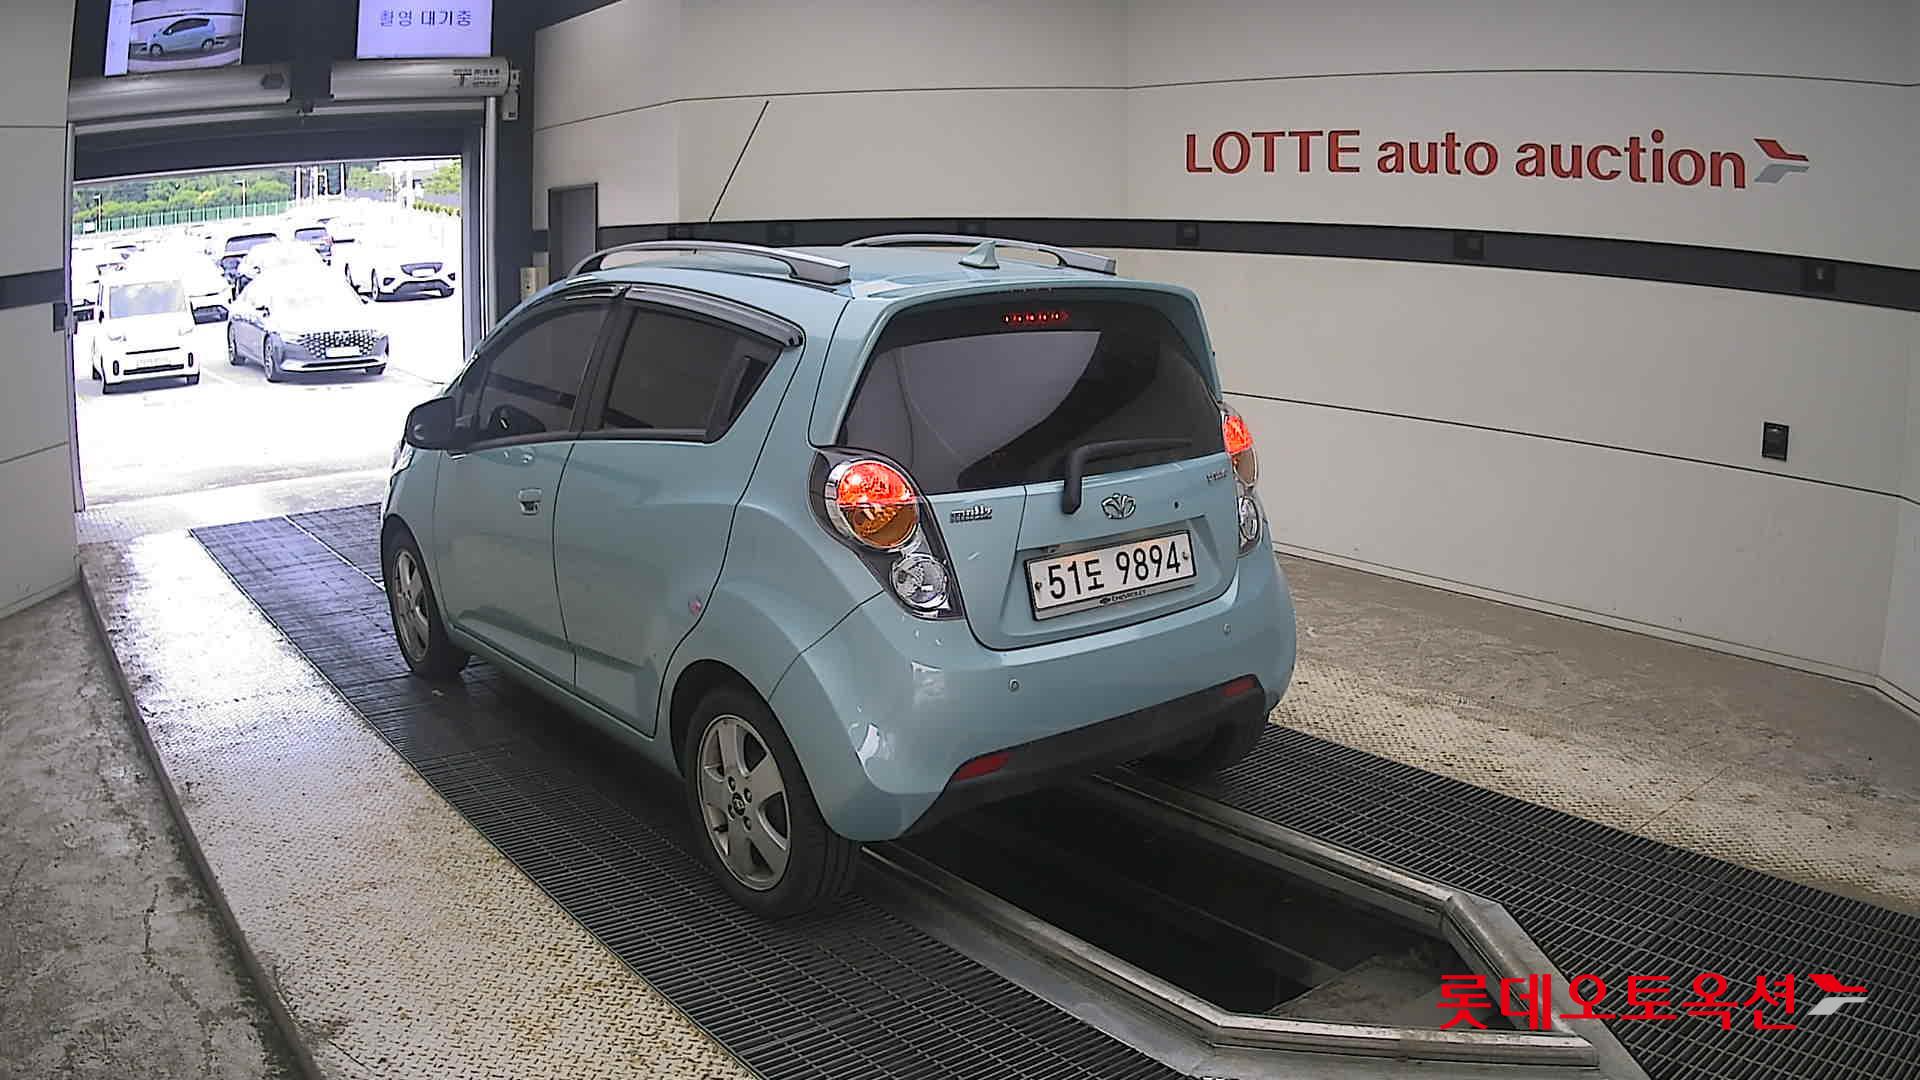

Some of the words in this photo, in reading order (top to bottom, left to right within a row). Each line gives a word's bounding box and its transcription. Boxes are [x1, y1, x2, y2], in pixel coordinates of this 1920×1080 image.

[421, 10, 472, 26] 대기중
[1186, 130, 1360, 174] LOTTE
[1377, 132, 1498, 175] auto
[1515, 129, 1746, 189] auction
[1048, 559, 1104, 600] 51도
[1116, 541, 1180, 585] 9894
